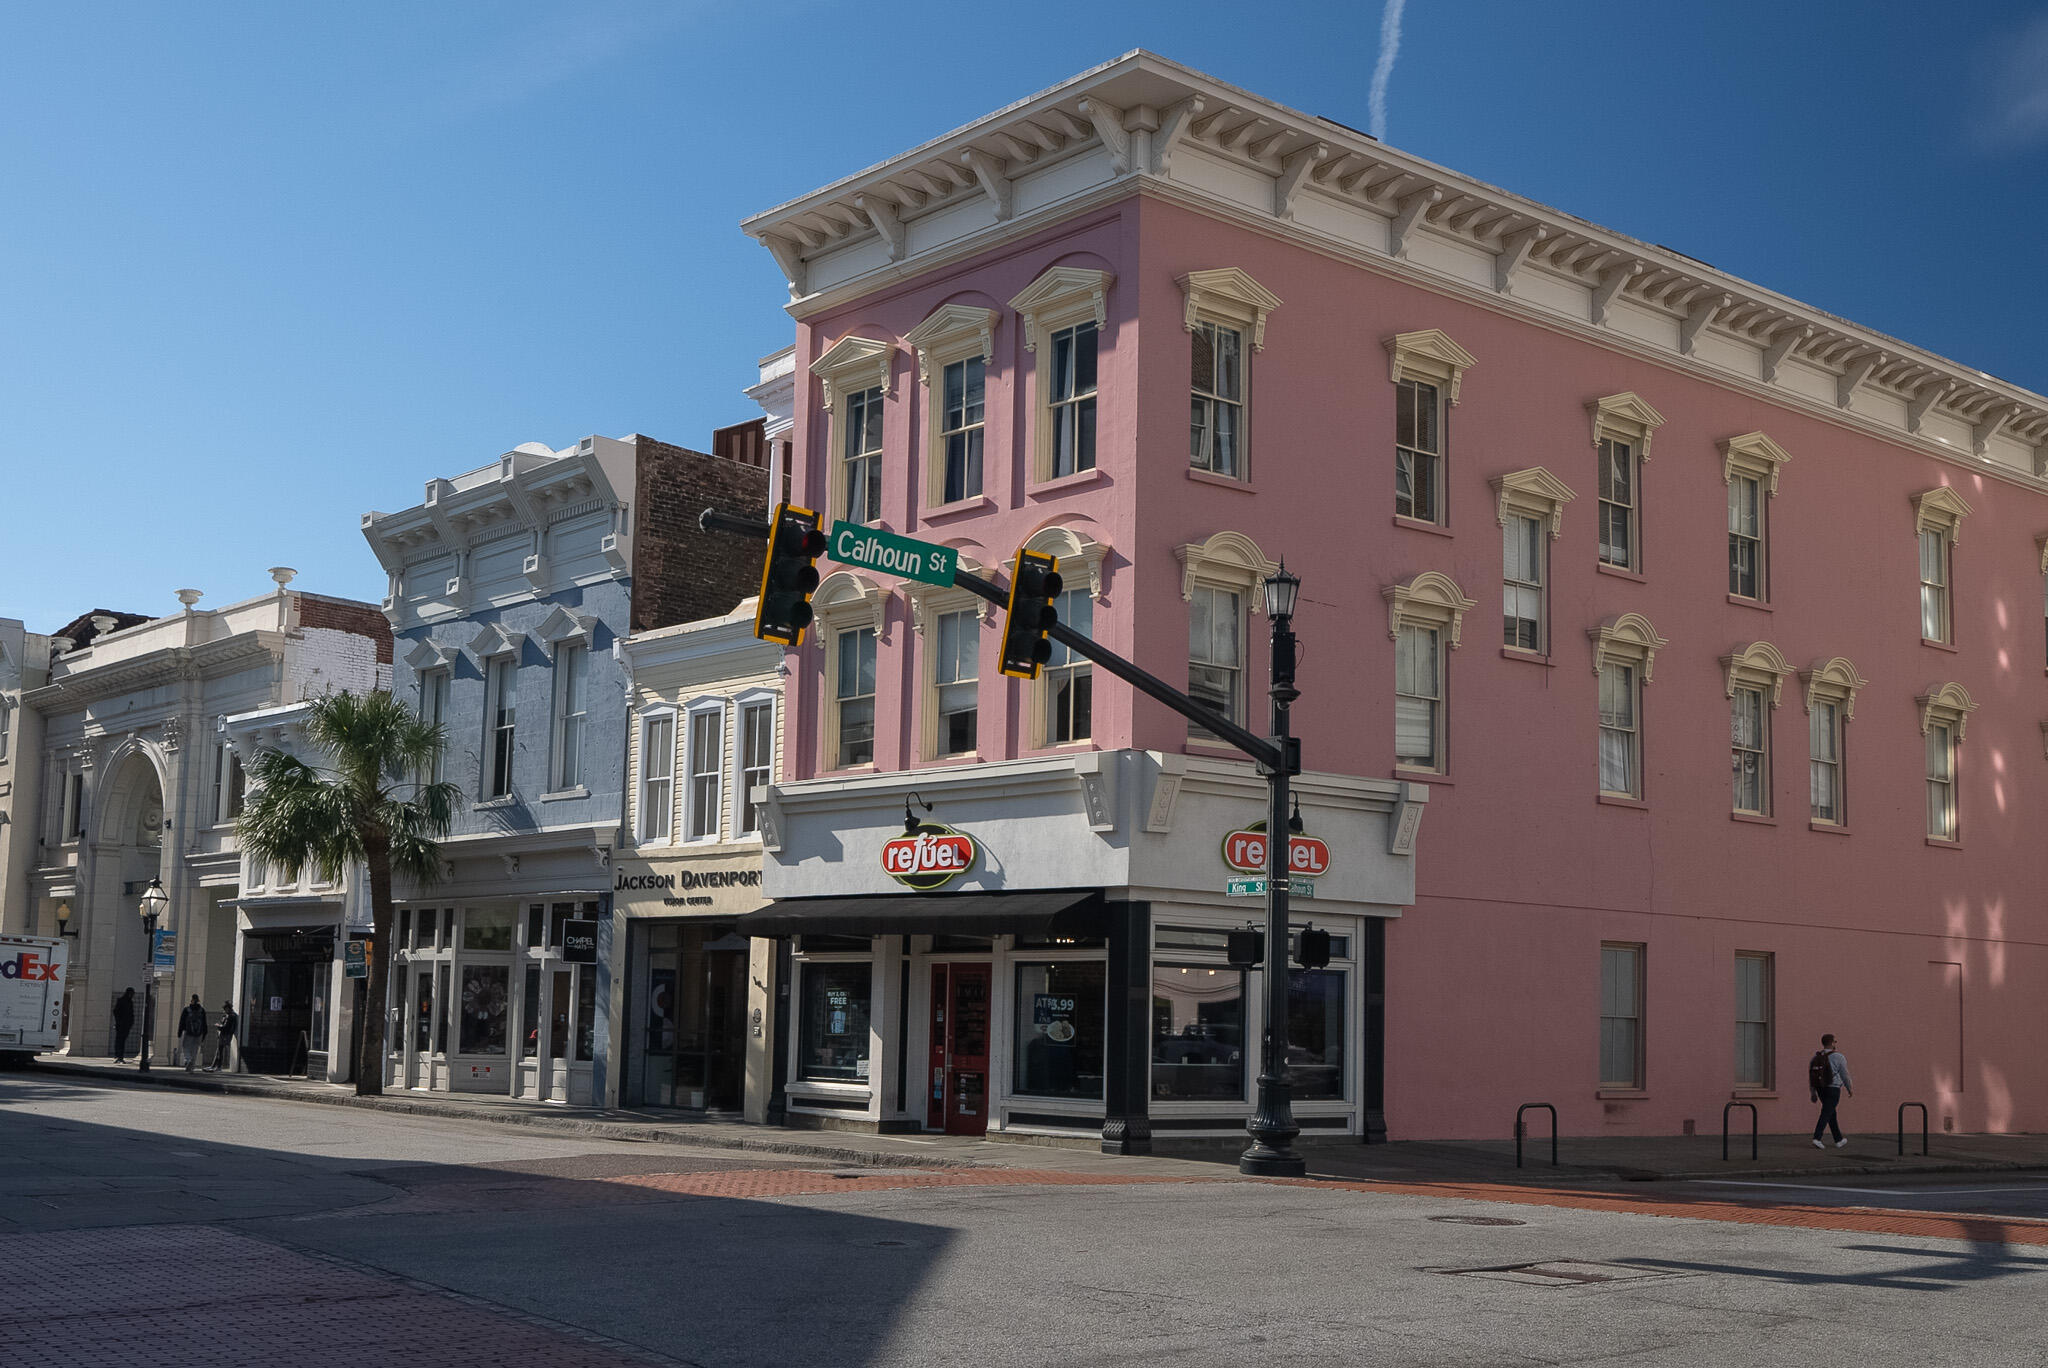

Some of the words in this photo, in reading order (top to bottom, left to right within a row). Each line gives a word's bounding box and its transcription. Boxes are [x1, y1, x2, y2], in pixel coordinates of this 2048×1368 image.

[837, 530, 921, 575] Calhoun
[929, 552, 947, 573] St
[614, 874, 675, 891] JACKSON
[1231, 882, 1247, 894] King
[1255, 881, 1264, 892] St
[686, 896, 713, 906] CENTER
[0, 952, 60, 981] dEx
[830, 997, 847, 1005] FREE
